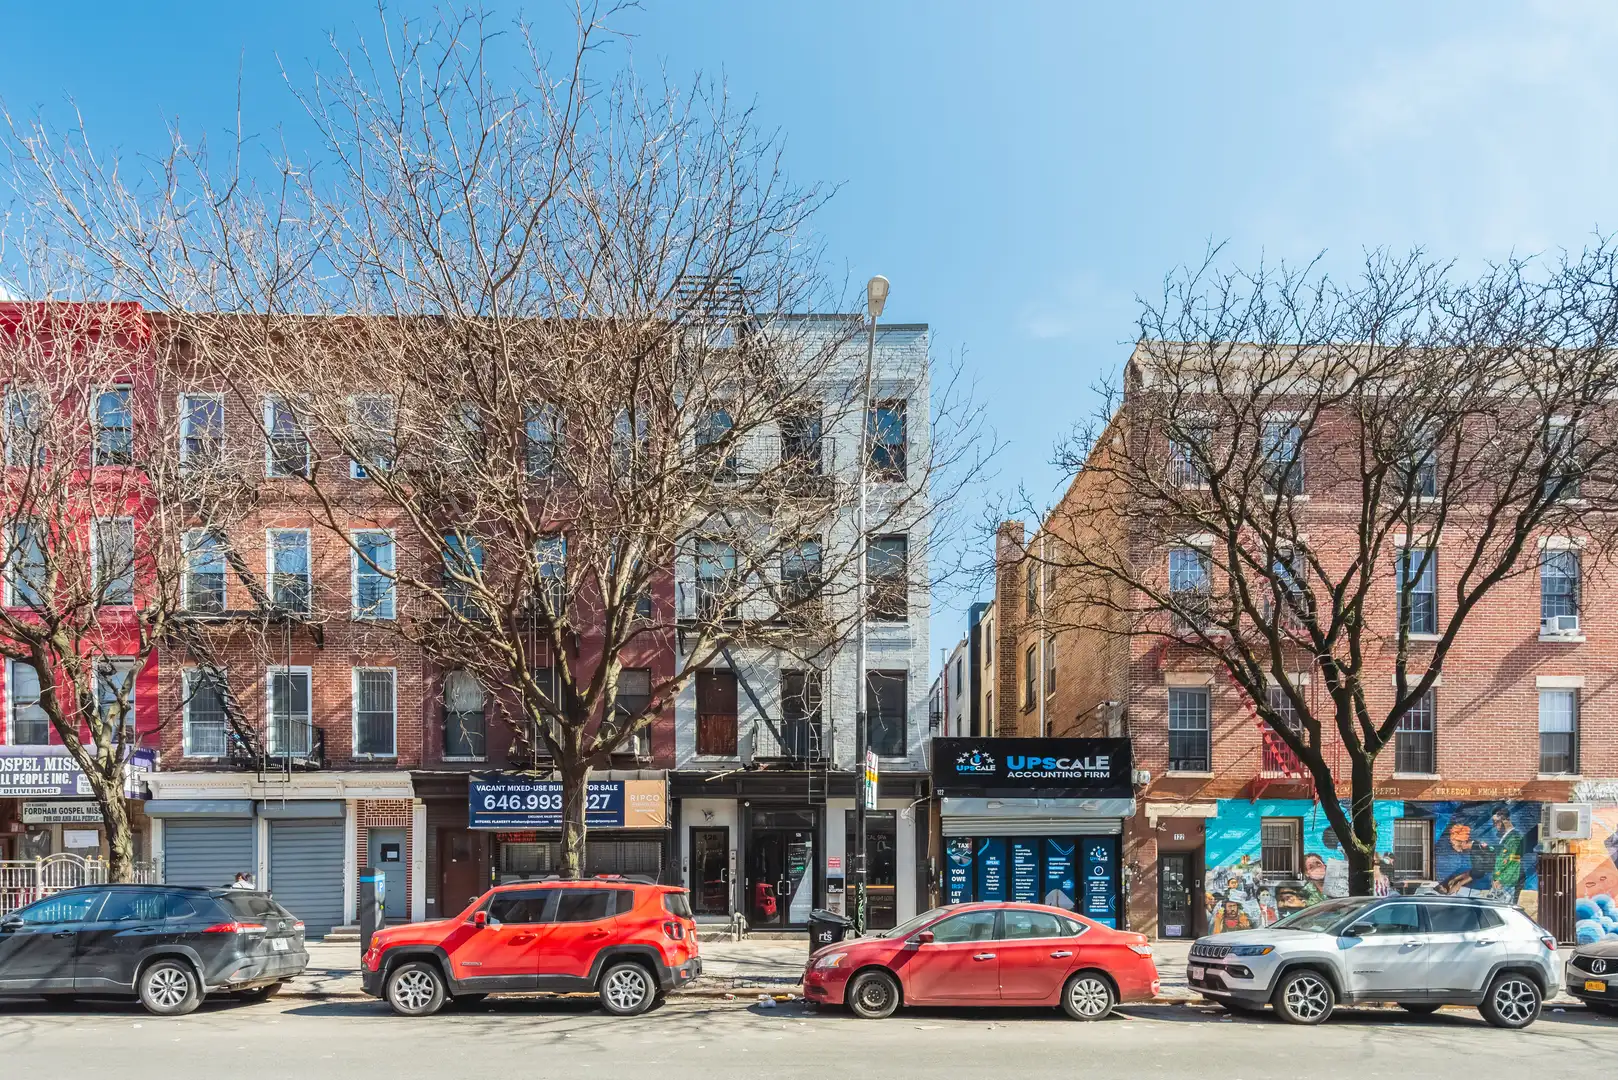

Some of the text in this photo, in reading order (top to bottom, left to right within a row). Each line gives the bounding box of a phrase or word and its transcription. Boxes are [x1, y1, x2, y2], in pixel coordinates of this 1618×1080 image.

[1006, 755, 1110, 770] UPSCALE
[13, 773, 50, 785] PEOPLE
[51, 772, 72, 785] INC.
[58, 807, 85, 815] GOSPEL
[819, 932, 833, 942] rts
